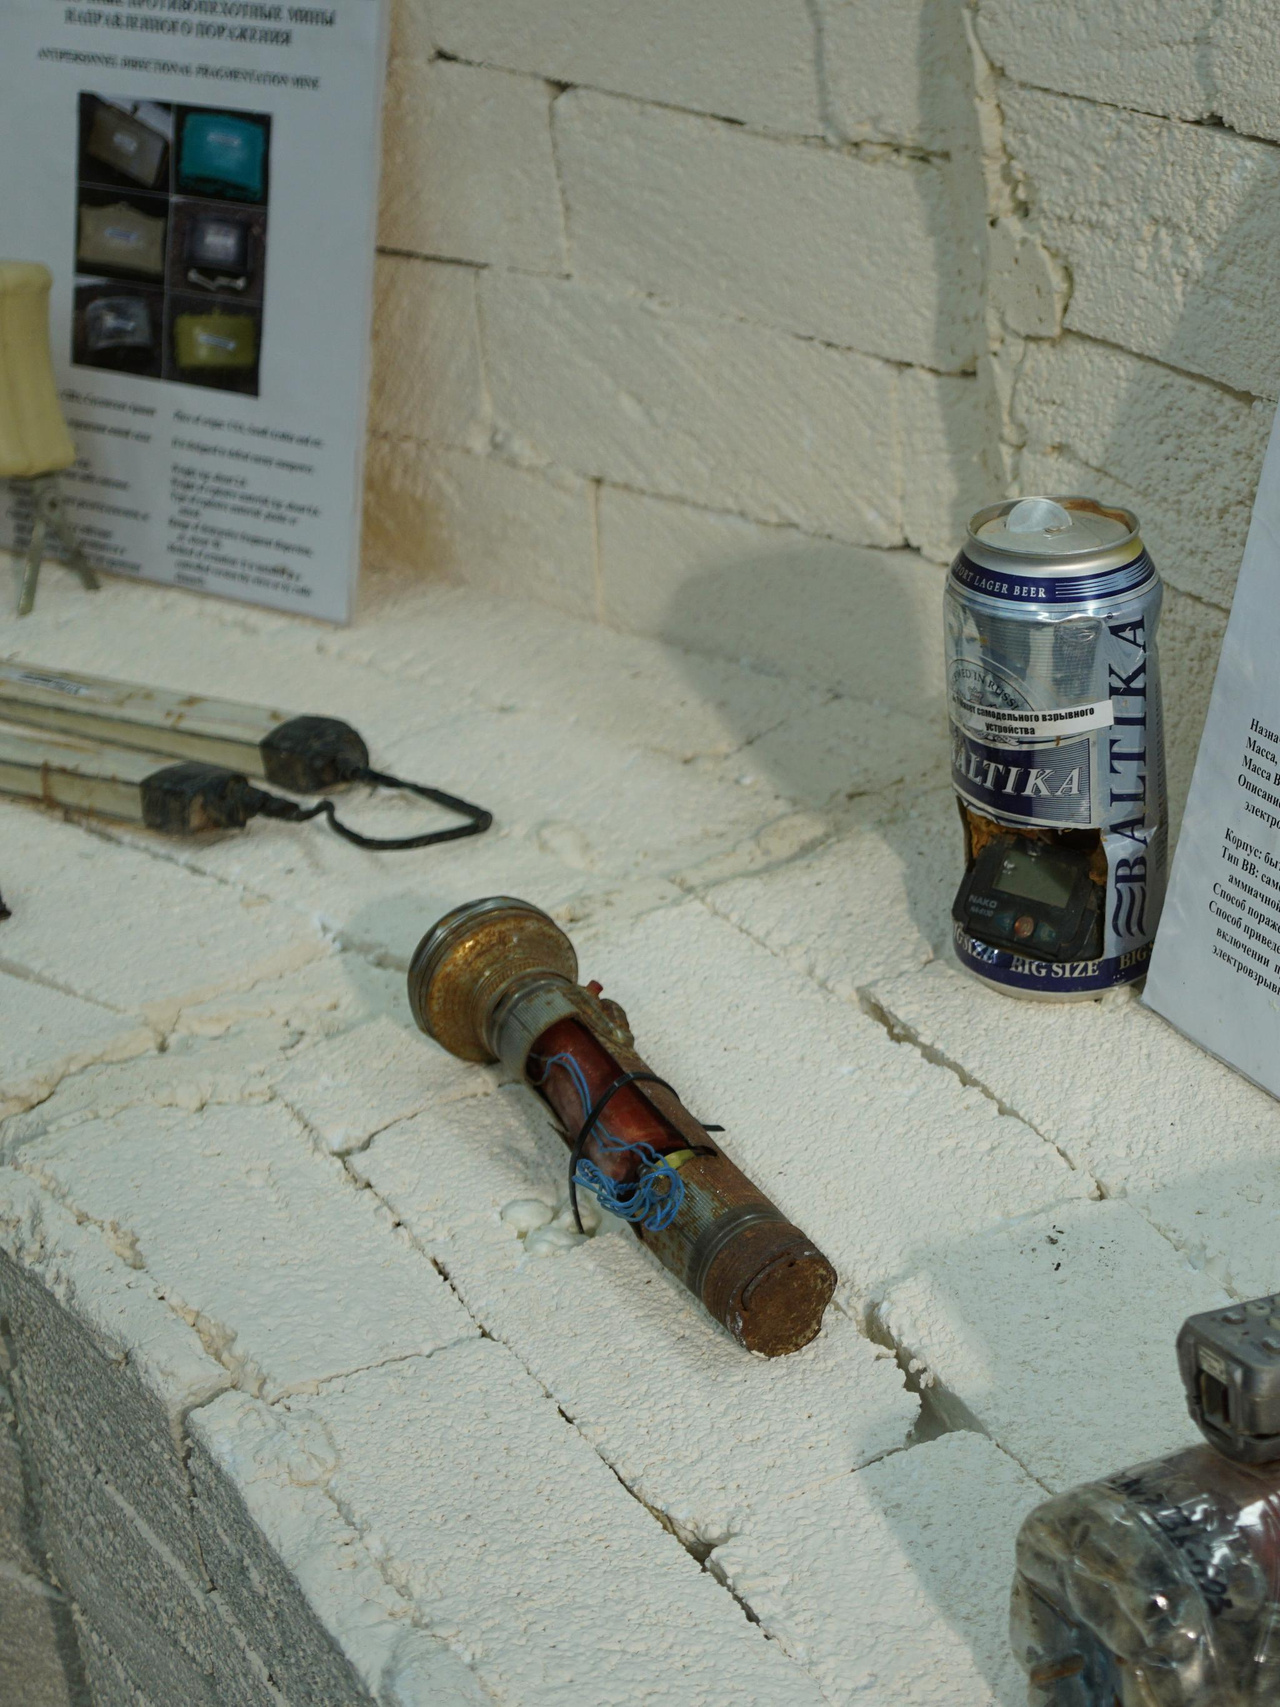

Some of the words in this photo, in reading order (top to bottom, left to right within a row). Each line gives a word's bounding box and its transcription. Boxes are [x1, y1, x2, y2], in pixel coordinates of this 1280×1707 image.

[974, 575, 1009, 594] LAGER
[1013, 585, 1047, 599] BEER
[977, 707, 1039, 722] самодельного
[1041, 707, 1096, 723] взрывного
[985, 722, 1037, 736] устройства
[1245, 735, 1278, 767] Масса,
[953, 749, 1081, 798] ALTIKA
[1241, 754, 1272, 782] Масса
[1224, 827, 1263, 860] Корпус:
[1221, 845, 1240, 867] Тип
[1240, 857, 1260, 879] ВВ:
[1212, 882, 1247, 912] Способ
[1208, 900, 1243, 930] Способ
[1119, 947, 1148, 970] BIG
[1215, 927, 1271, 968] включении
[1051, 960, 1101, 979] SIZE
